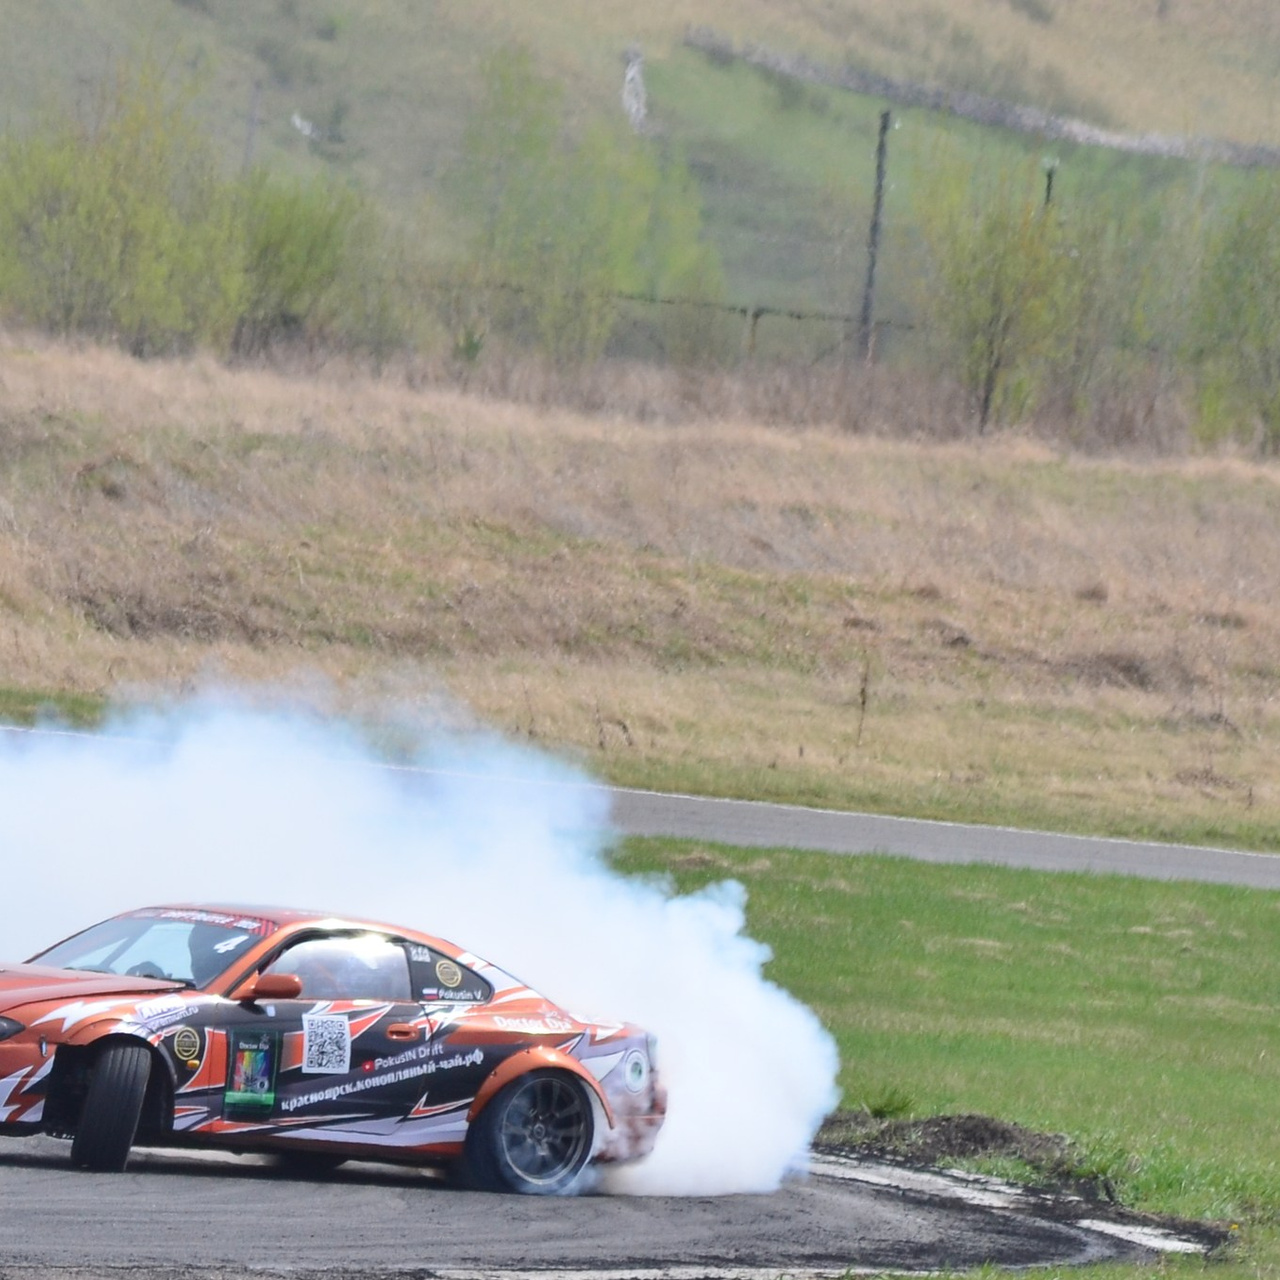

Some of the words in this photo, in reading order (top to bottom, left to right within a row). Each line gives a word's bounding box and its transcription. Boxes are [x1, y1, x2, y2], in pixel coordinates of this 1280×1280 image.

[213, 935, 249, 954] 4
[374, 1050, 418, 1071] PokusIN
[419, 1043, 445, 1062] Drift
[281, 1048, 485, 1112] красноярск.конопляный-чай.рф
